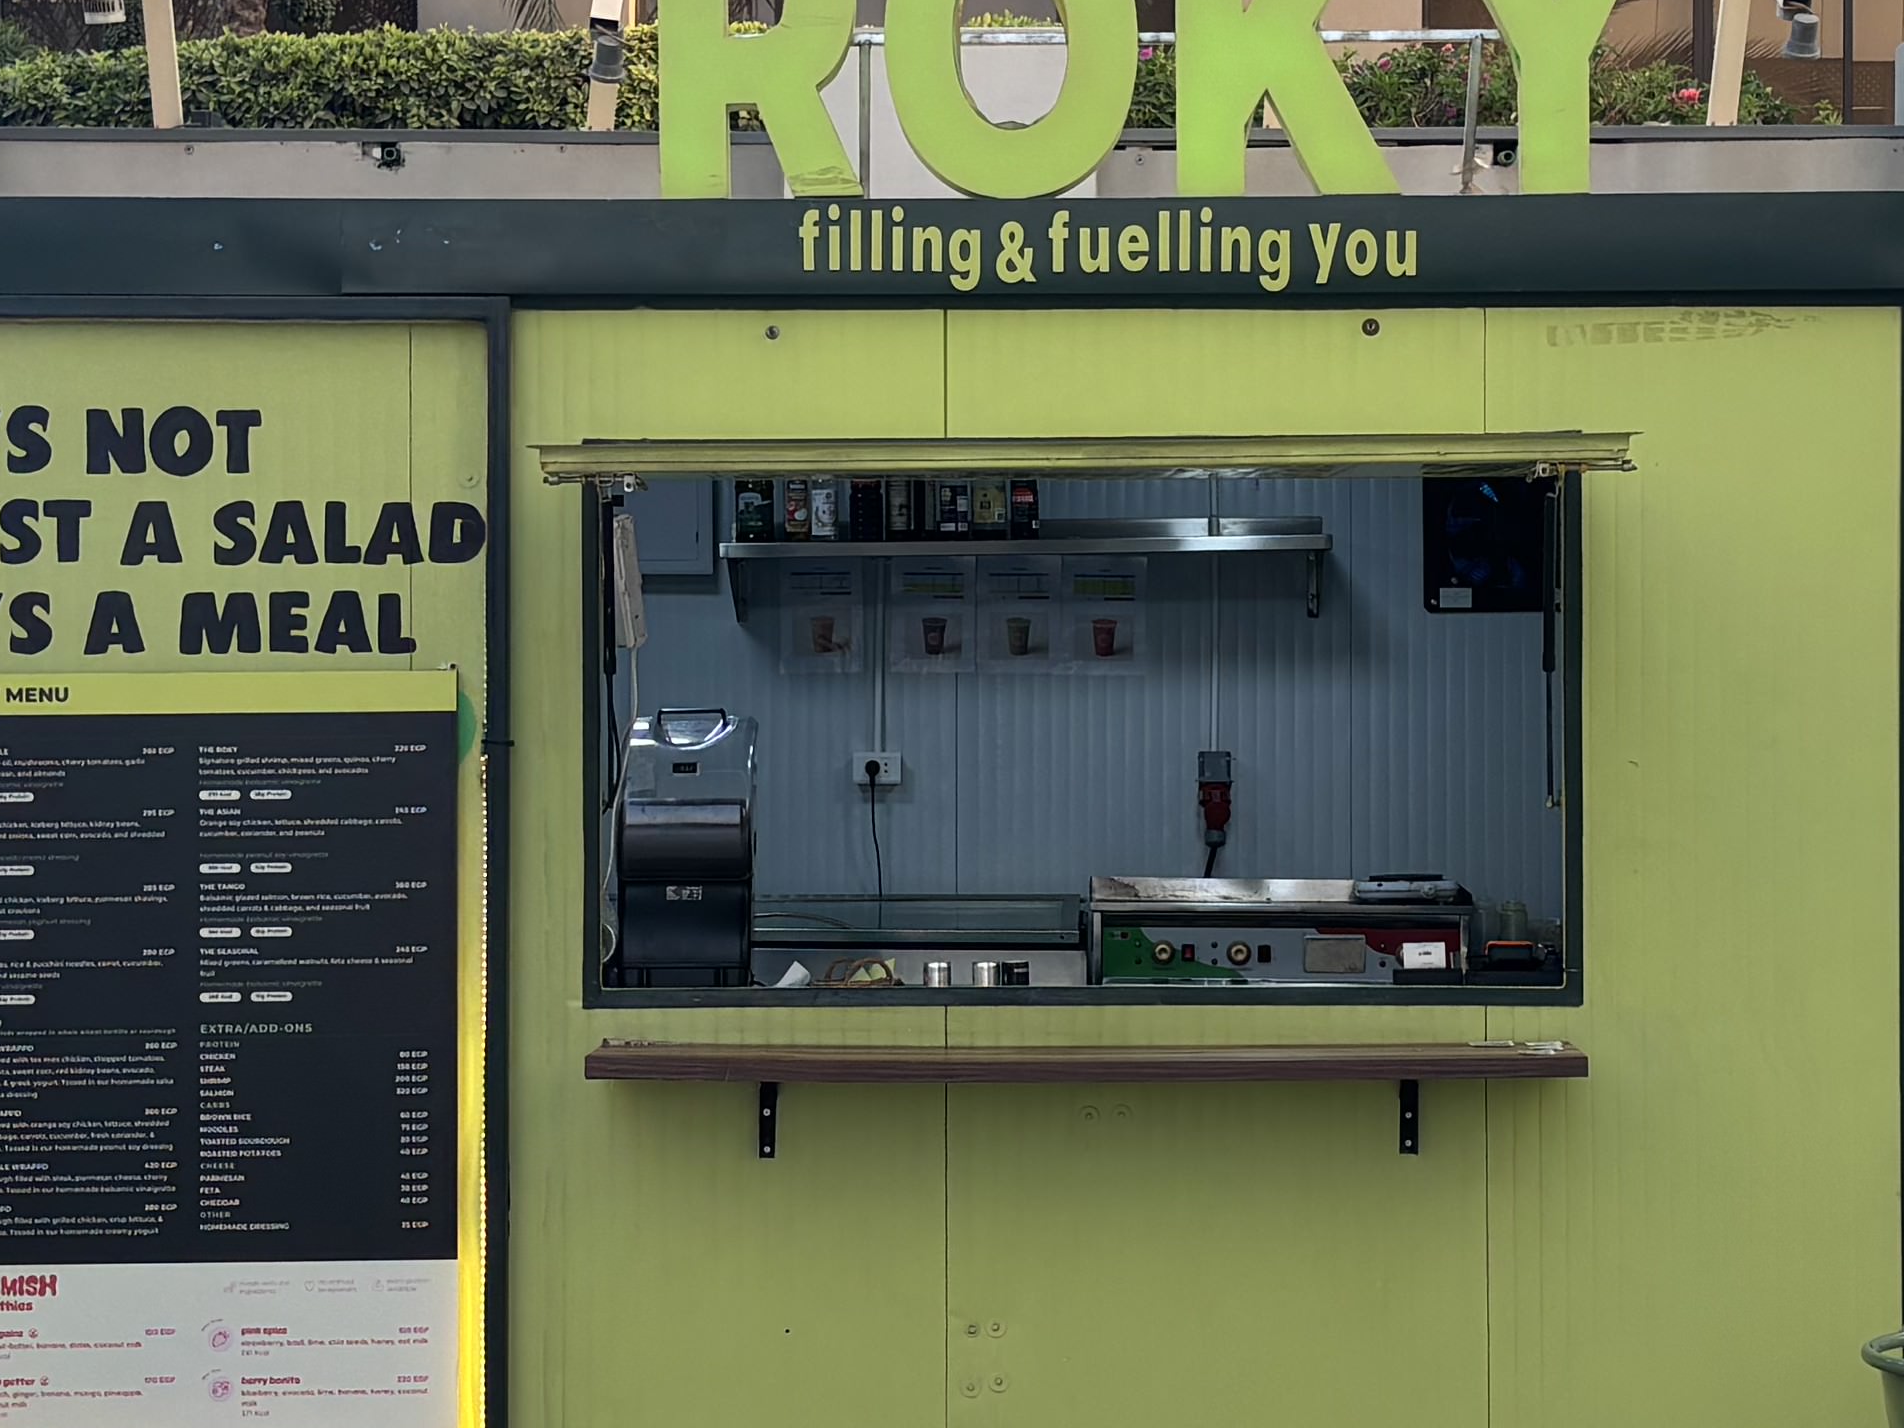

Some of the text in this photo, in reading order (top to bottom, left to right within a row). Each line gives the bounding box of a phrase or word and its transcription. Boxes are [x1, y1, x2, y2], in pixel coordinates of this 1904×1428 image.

[799, 205, 1418, 293] filling & fuelling you
[86, 406, 262, 476] NOT
[120, 501, 183, 565] A
[213, 501, 486, 565] SALAD
[84, 591, 146, 655] A
[179, 591, 416, 655] MEAL
[5, 686, 69, 703] MENU
[199, 883, 216, 891] THE
[200, 1023, 313, 1034] EXTRA/ADD-ONS
[1, 1275, 57, 1297] MISH
